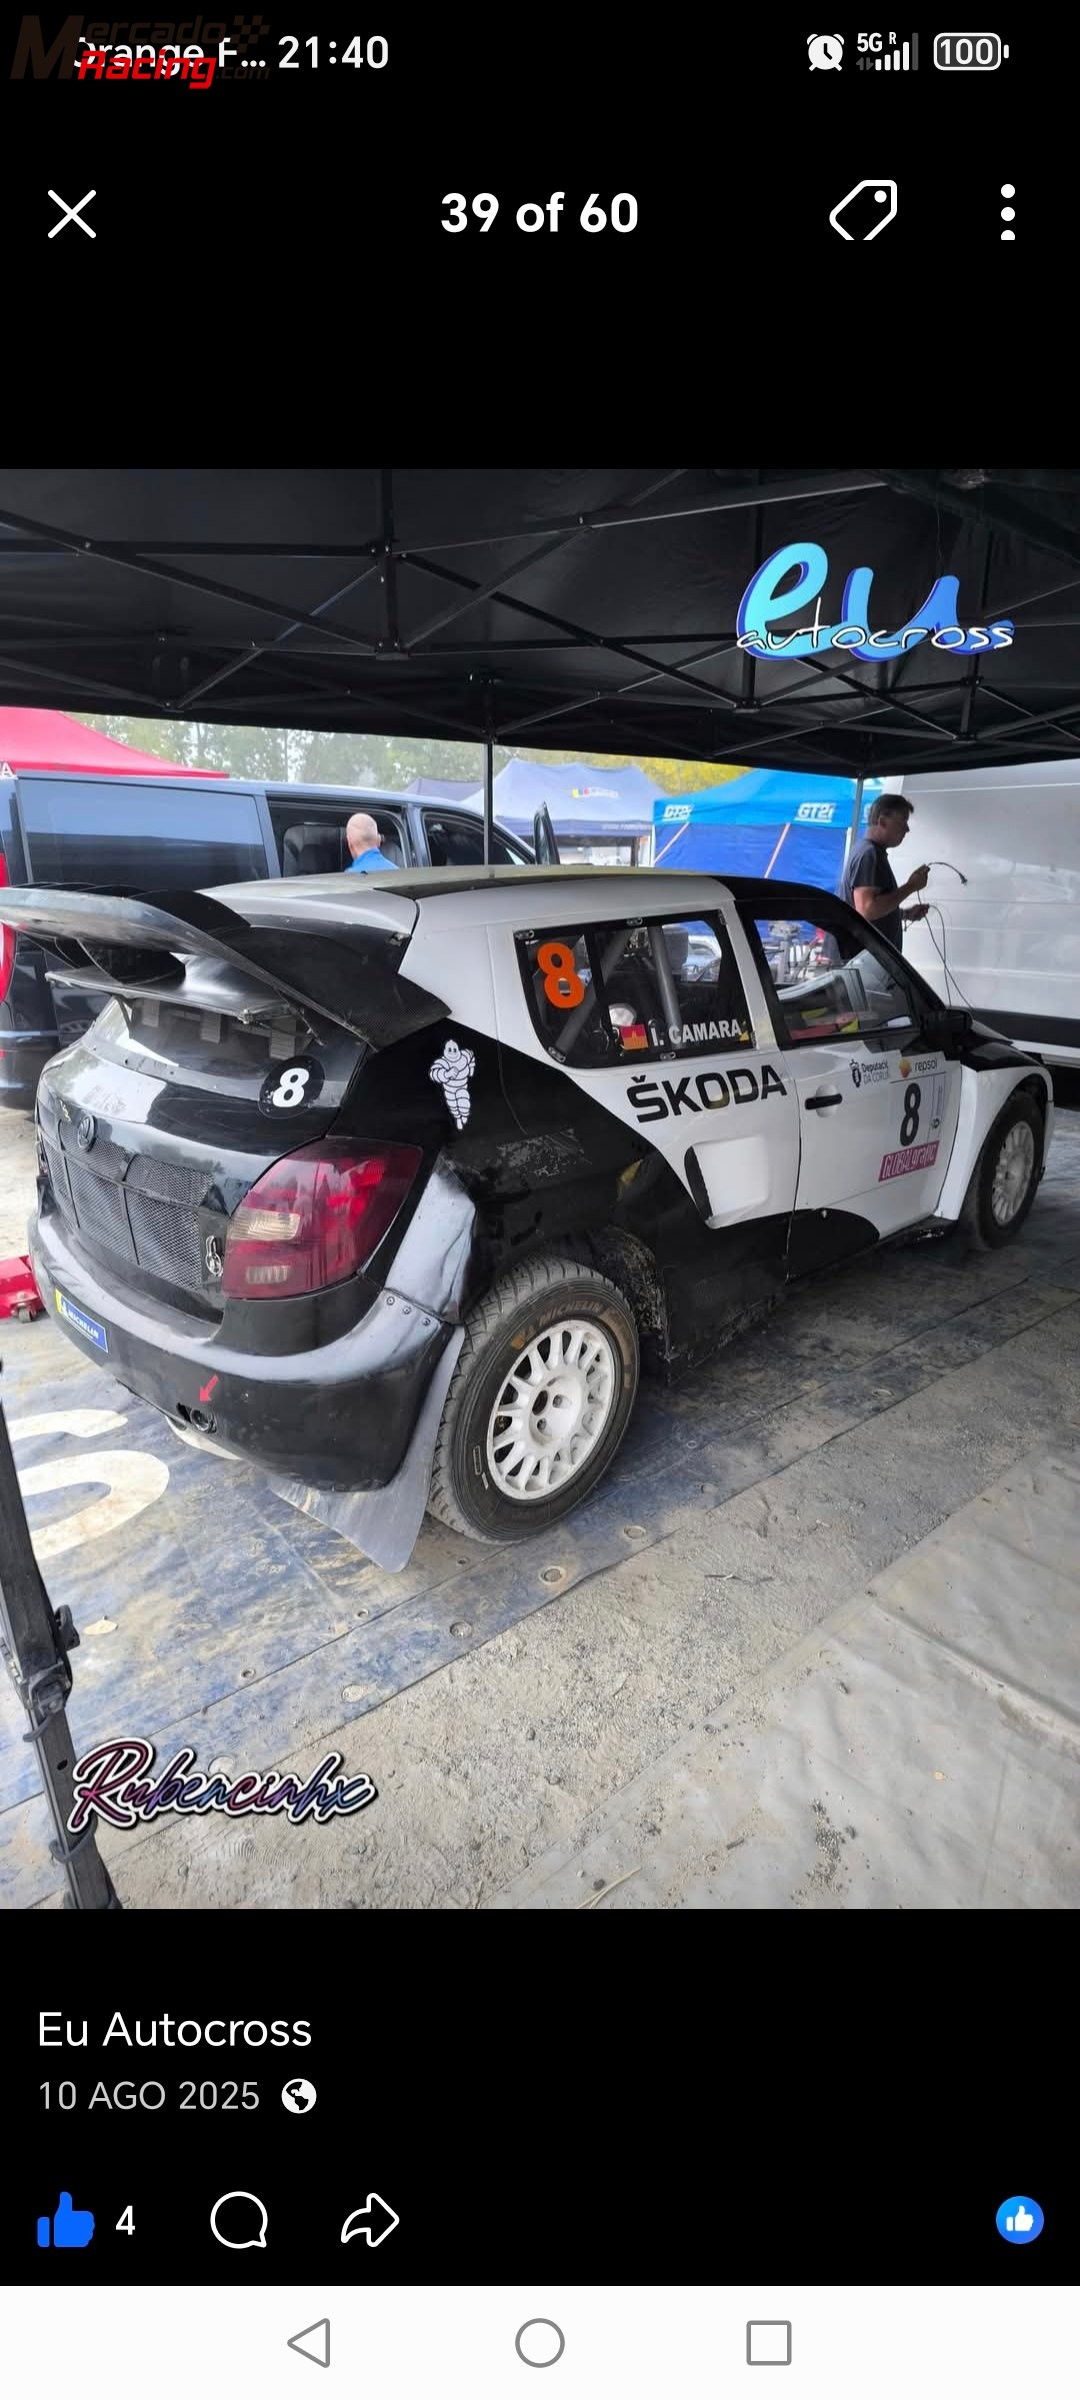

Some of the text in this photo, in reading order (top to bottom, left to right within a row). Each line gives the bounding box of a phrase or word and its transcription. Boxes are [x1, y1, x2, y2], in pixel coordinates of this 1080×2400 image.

[797, 802, 837, 818] GT2i
[536, 941, 586, 1009] 8
[668, 1018, 743, 1045] CAMARA
[914, 1058, 938, 1072] repsol
[272, 1067, 310, 1108] 8
[626, 1064, 788, 1124] ŠKODA
[899, 1082, 922, 1147] 8
